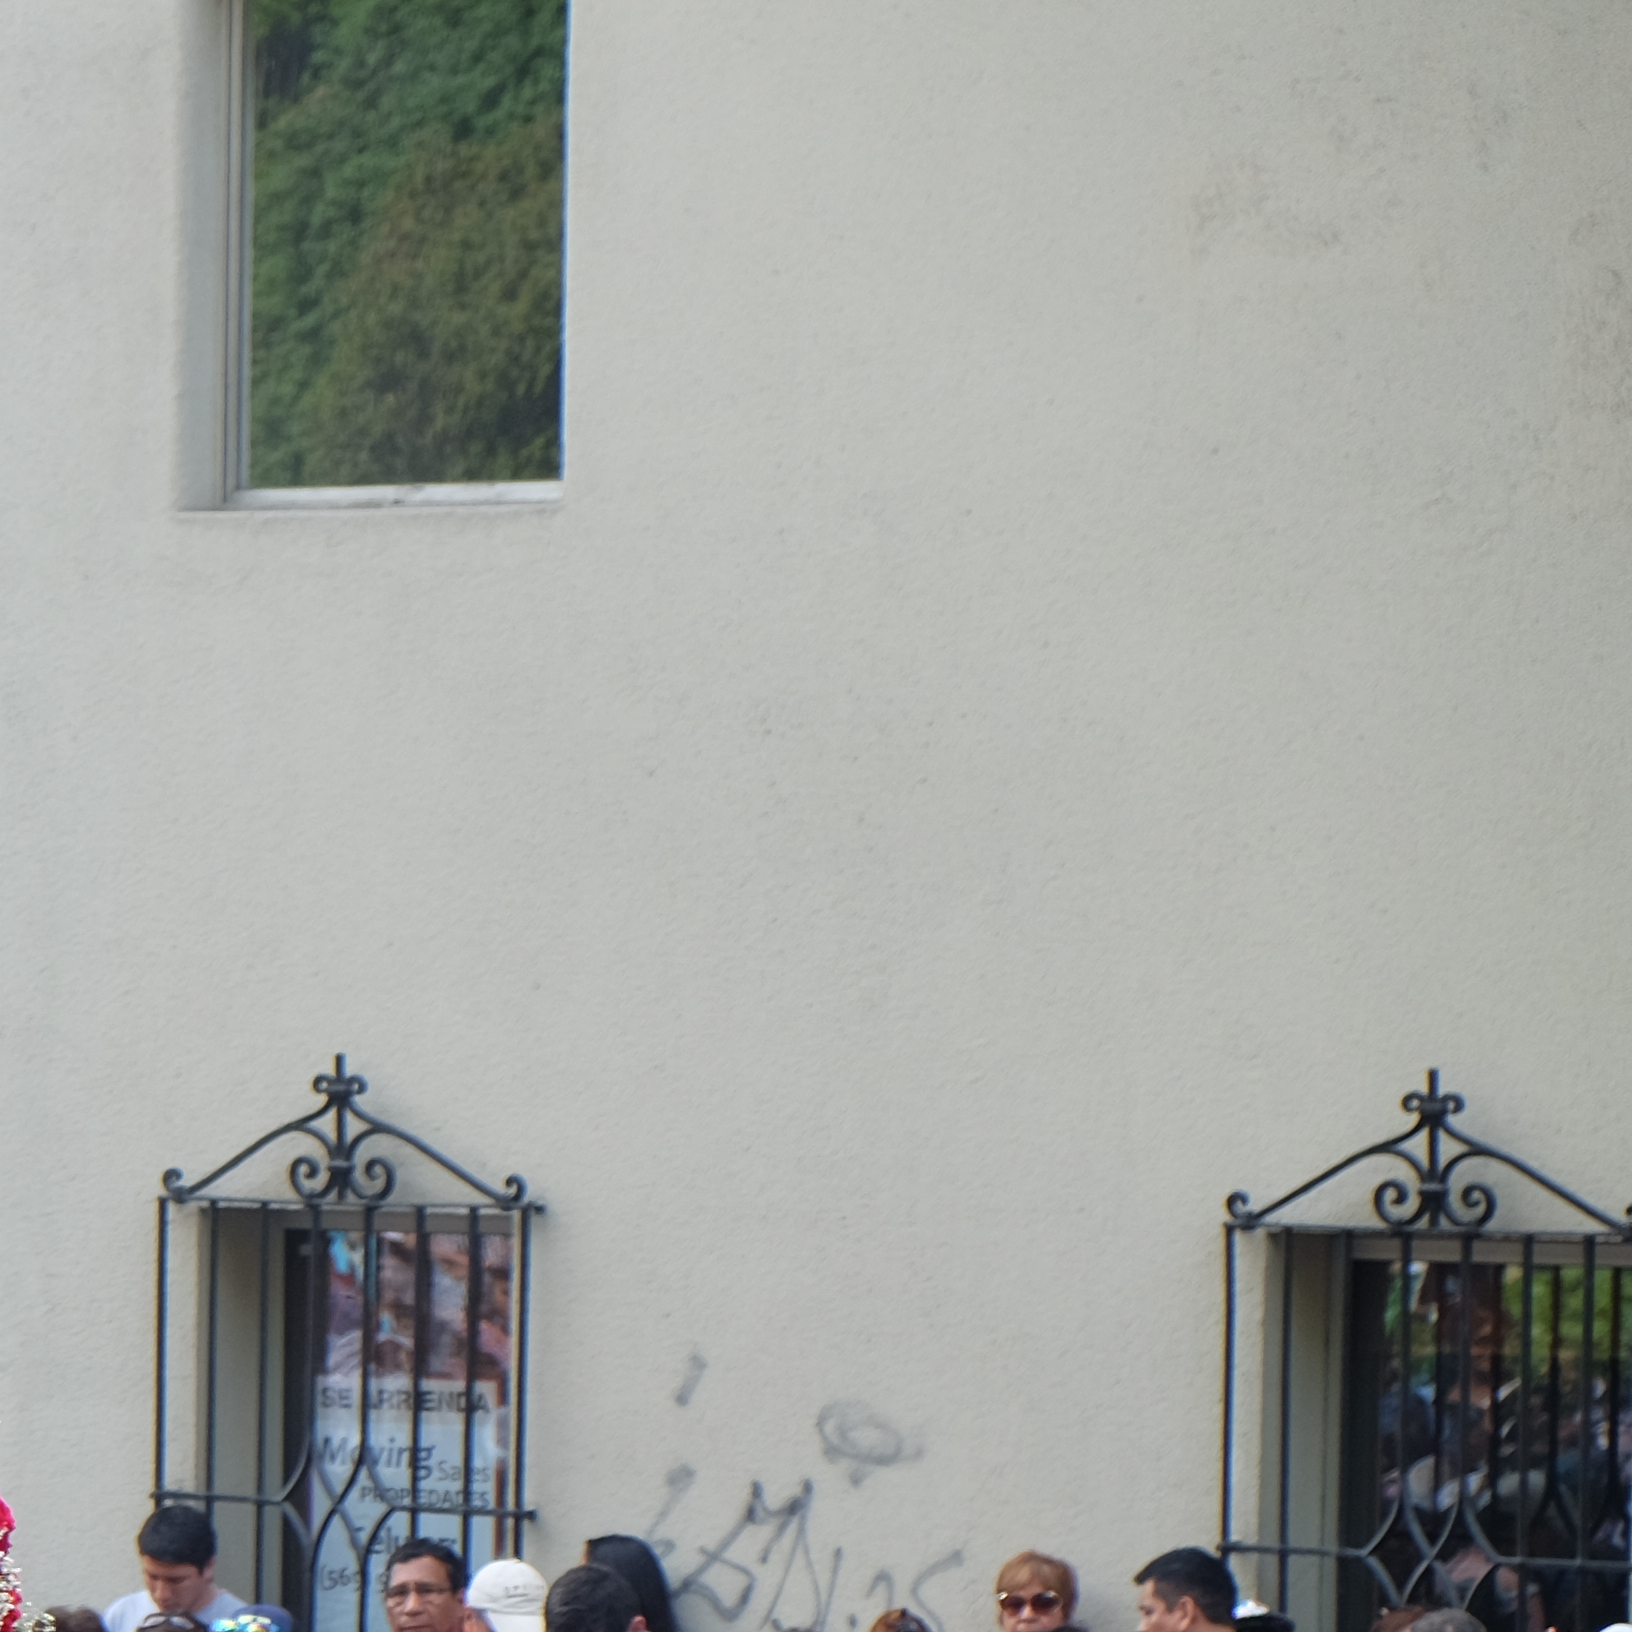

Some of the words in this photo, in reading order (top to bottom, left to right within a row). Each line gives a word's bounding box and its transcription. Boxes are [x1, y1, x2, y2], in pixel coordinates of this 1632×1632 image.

[320, 1386, 353, 1409] SE
[366, 1388, 490, 1414] RRENDA
[437, 1460, 491, 1483] Saes
[360, 1486, 491, 1509] PROPEDADES
